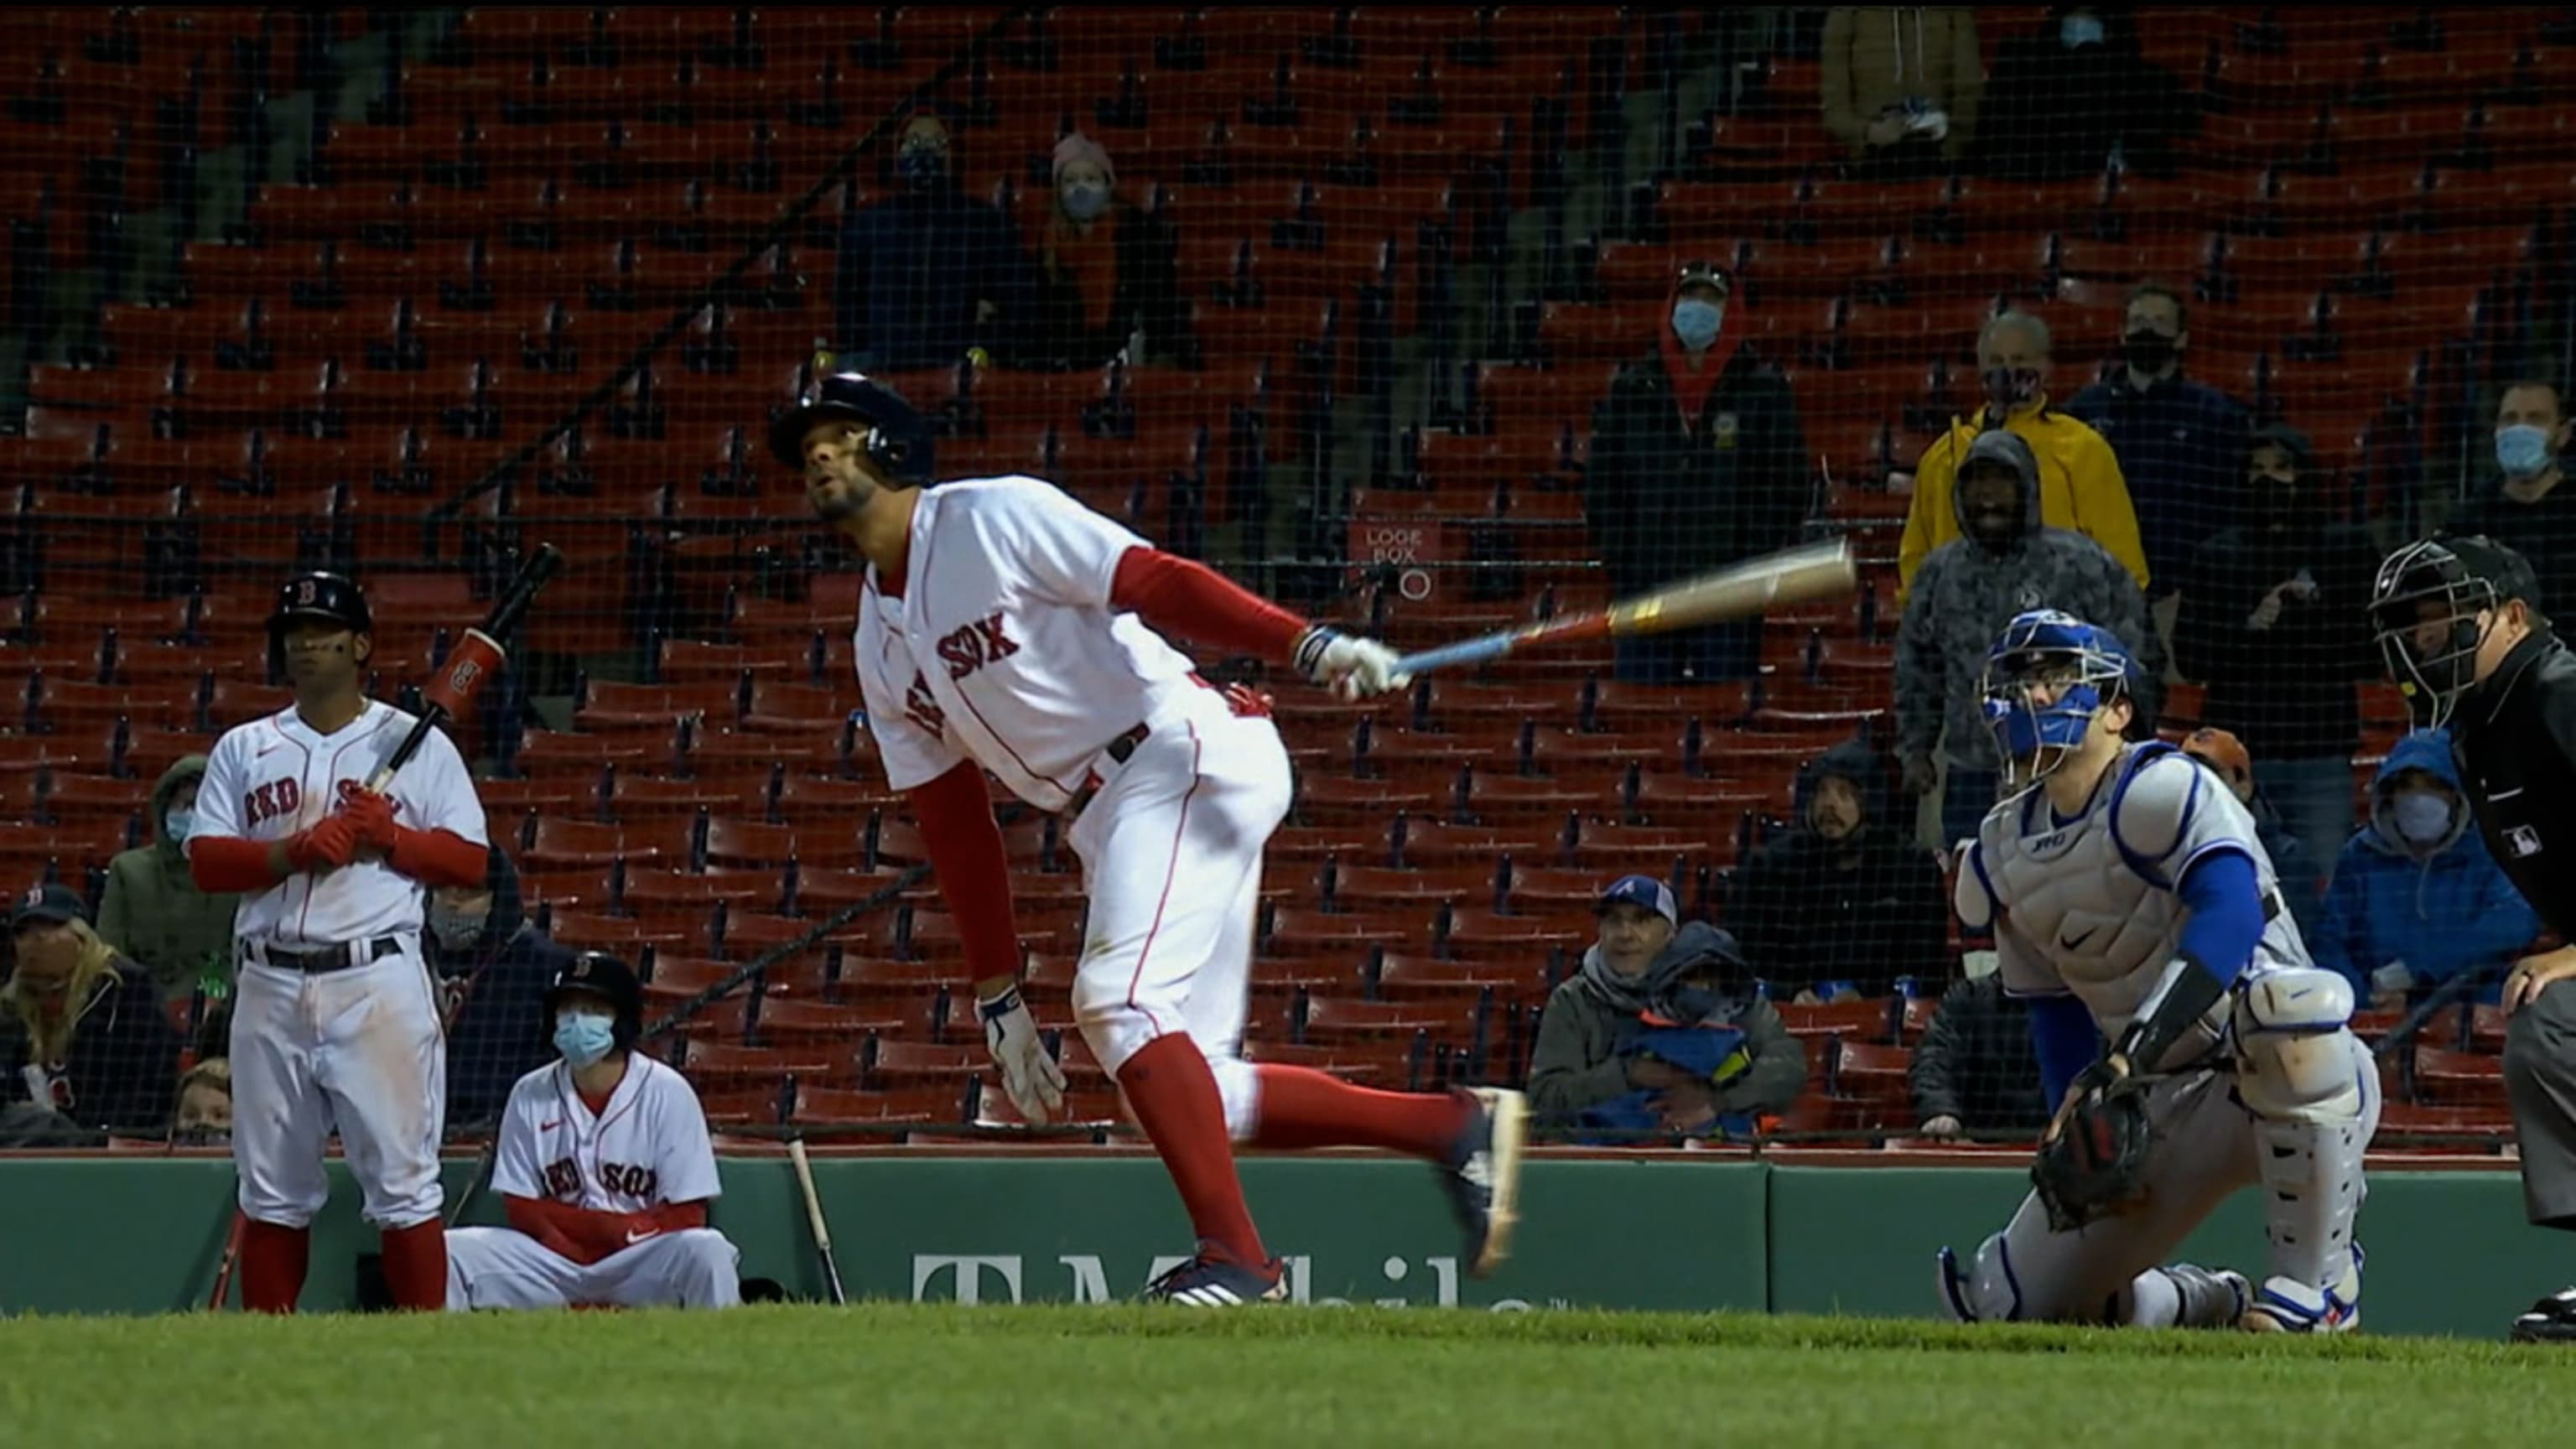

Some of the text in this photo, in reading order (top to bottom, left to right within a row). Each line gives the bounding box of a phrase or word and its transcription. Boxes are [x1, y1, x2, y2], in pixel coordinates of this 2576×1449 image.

[298, 579, 317, 605] B
[937, 610, 1020, 682] SOX
[538, 1156, 581, 1197] ED
